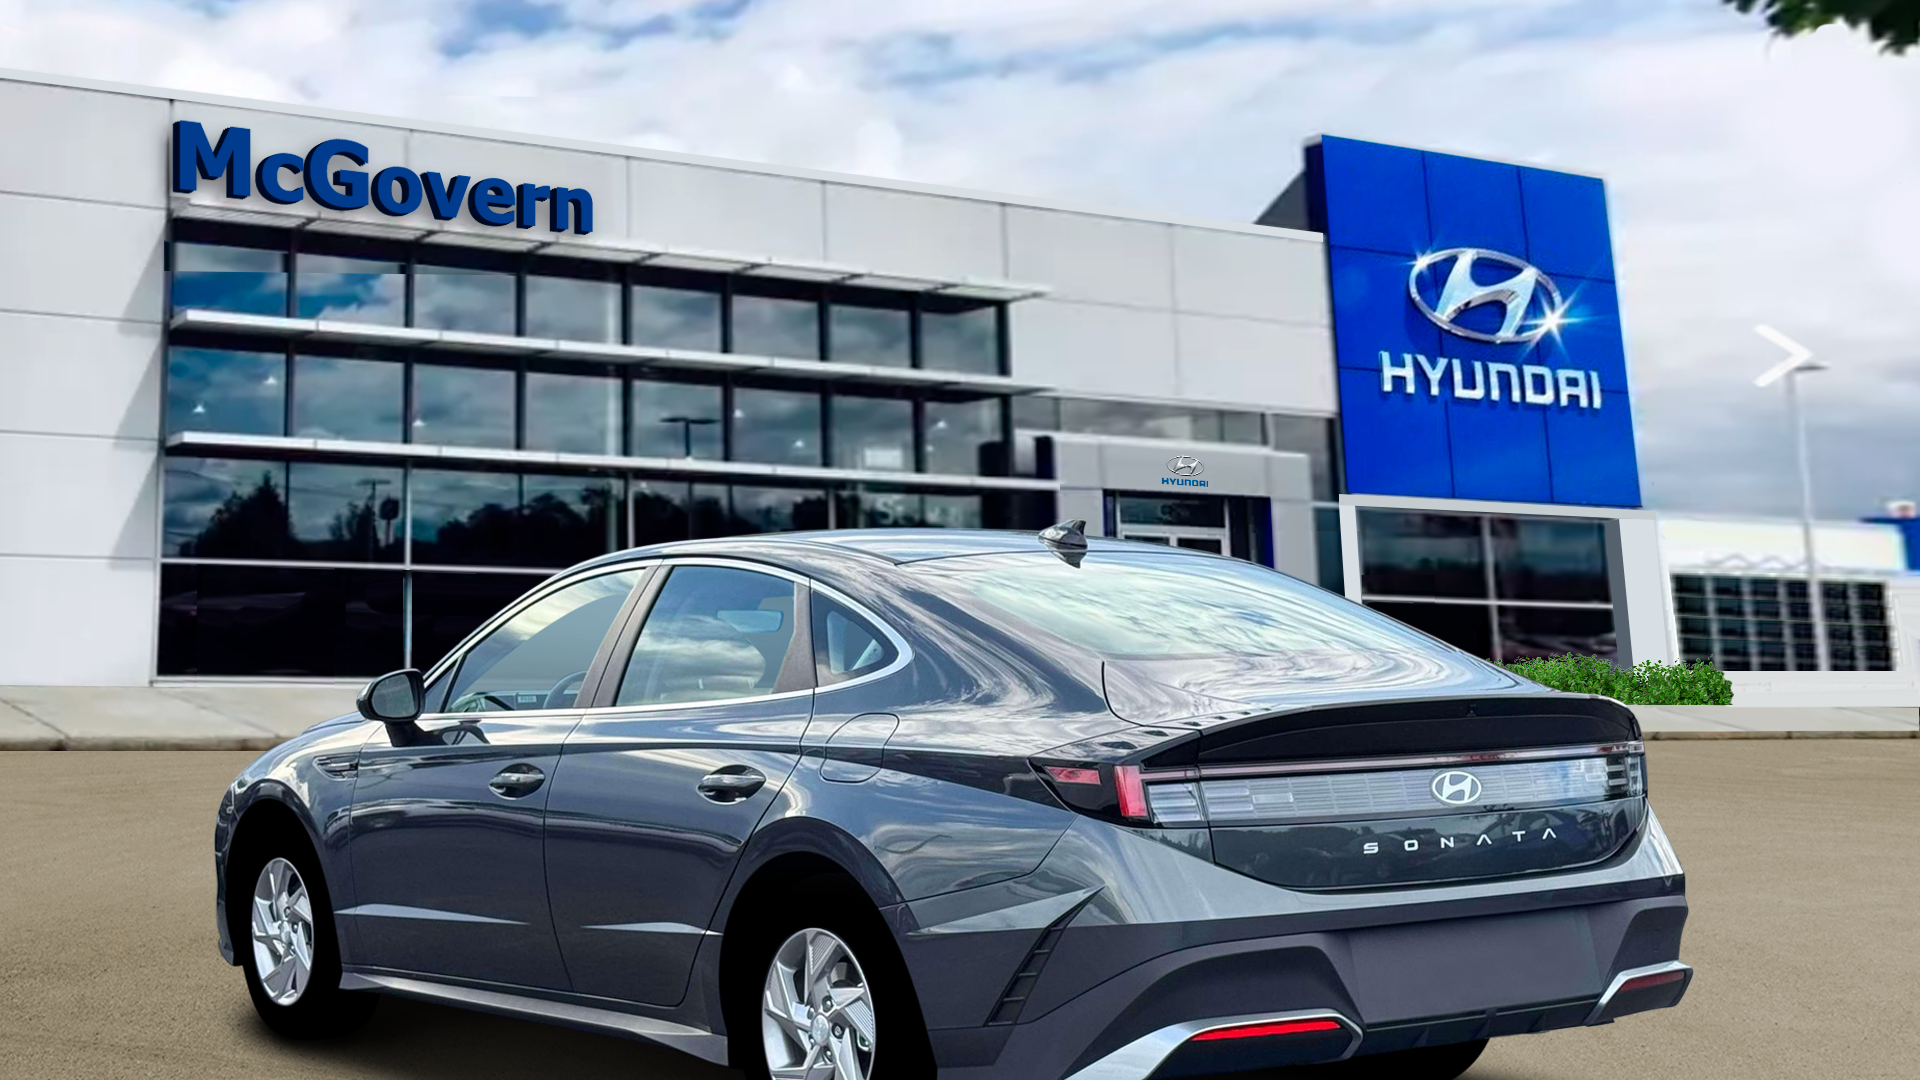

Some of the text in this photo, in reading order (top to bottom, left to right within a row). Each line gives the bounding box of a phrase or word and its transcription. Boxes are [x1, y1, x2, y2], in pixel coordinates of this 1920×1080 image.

[172, 120, 593, 235] McGovern
[1378, 350, 1601, 409] HYUNDAI
[1161, 477, 1209, 488] HYUNDAI
[1363, 827, 1557, 854] SONATA
